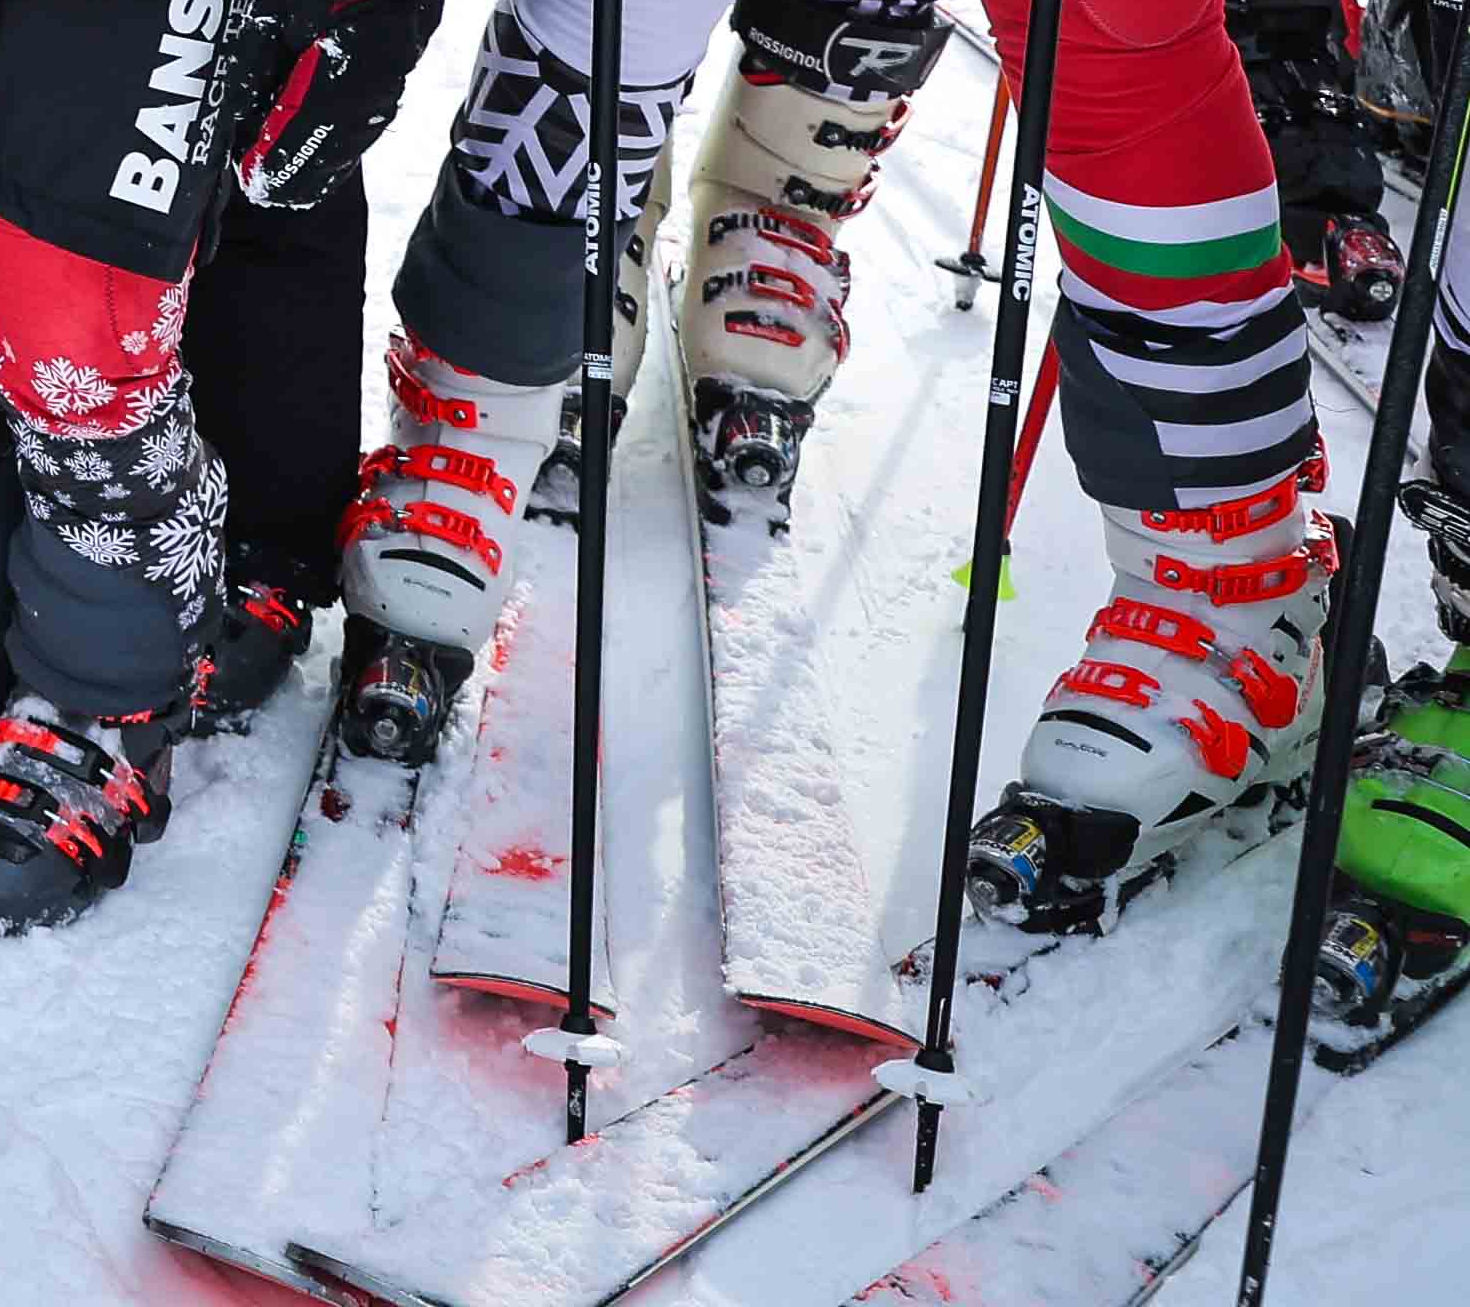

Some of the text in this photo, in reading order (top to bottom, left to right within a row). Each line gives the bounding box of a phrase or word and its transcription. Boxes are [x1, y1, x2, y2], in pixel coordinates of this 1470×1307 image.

[747, 27, 824, 75] ROSSIGNOL
[191, 52, 235, 166] RACE
[269, 124, 335, 189] ROSSIGNOL
[583, 162, 603, 276] ATOMIC
[1010, 182, 1041, 302] ATOMIC
